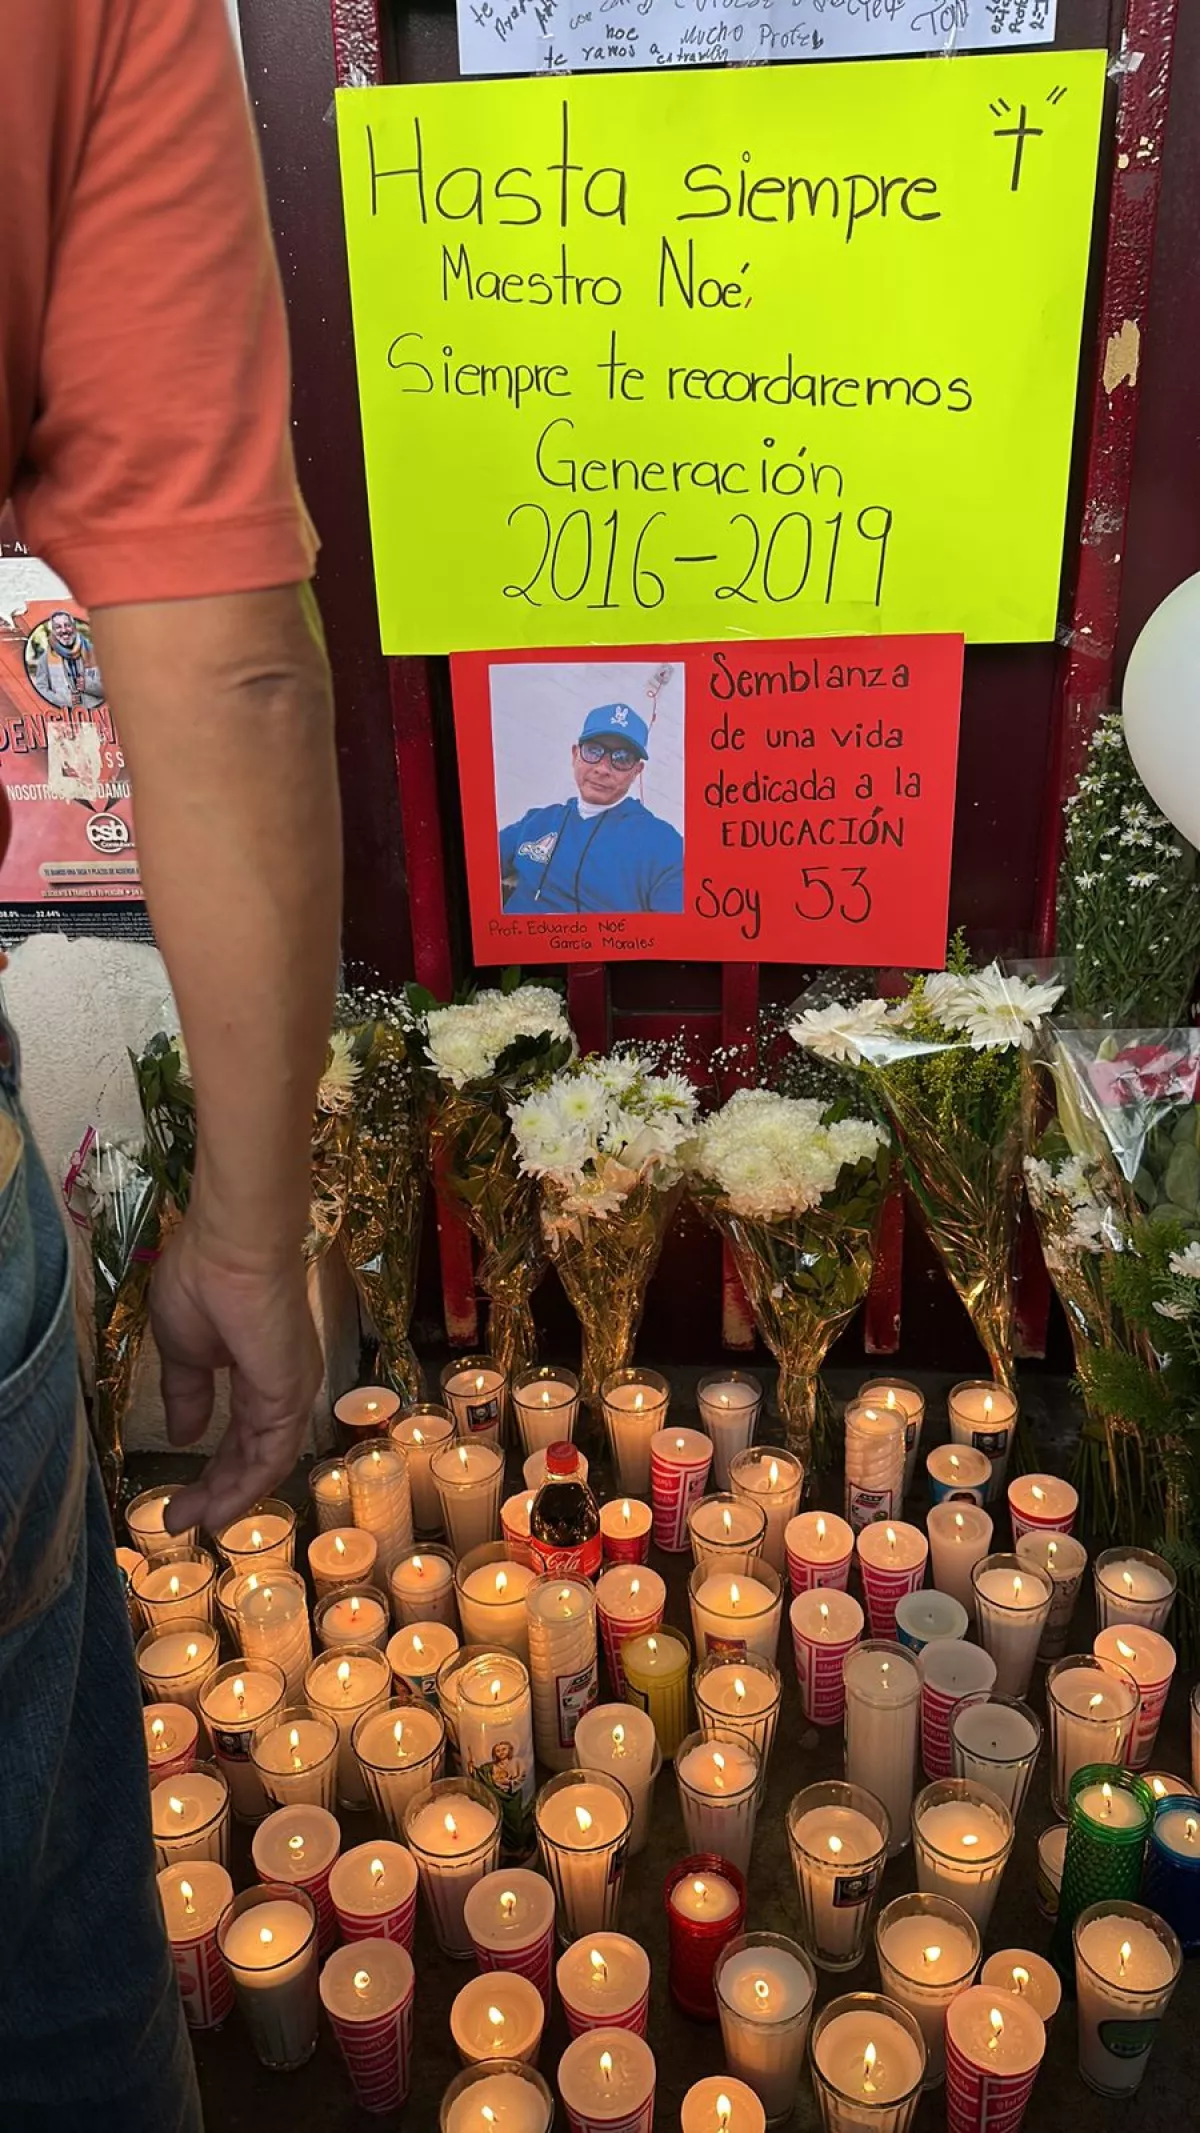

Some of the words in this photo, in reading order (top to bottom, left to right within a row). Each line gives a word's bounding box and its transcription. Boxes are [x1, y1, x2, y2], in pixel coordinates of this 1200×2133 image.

[366, 101, 627, 227] Hasta
[676, 151, 942, 244] siempre
[442, 244, 622, 306] Maestro
[388, 332, 572, 408] Siempre
[596, 330, 645, 401] te
[668, 353, 973, 413] recordaremos
[536, 418, 844, 497] Generación
[503, 503, 893, 608] 2016-2019
[710, 652, 909, 699] Semblanza
[711, 713, 746, 751] de
[766, 728, 816, 749] una
[830, 720, 904, 749] vida
[704, 768, 836, 808] dedicada
[854, 773, 873, 800] a
[895, 766, 921, 799] la
[722, 806, 904, 848] EDUCACIÓN
[695, 878, 761, 939] Soy
[795, 867, 872, 923] 53
[489, 920, 523, 937] Prof.
[527, 920, 589, 936] Eduardo
[601, 935, 656, 951] Morales
[546, 1548, 585, 1570] Cola
